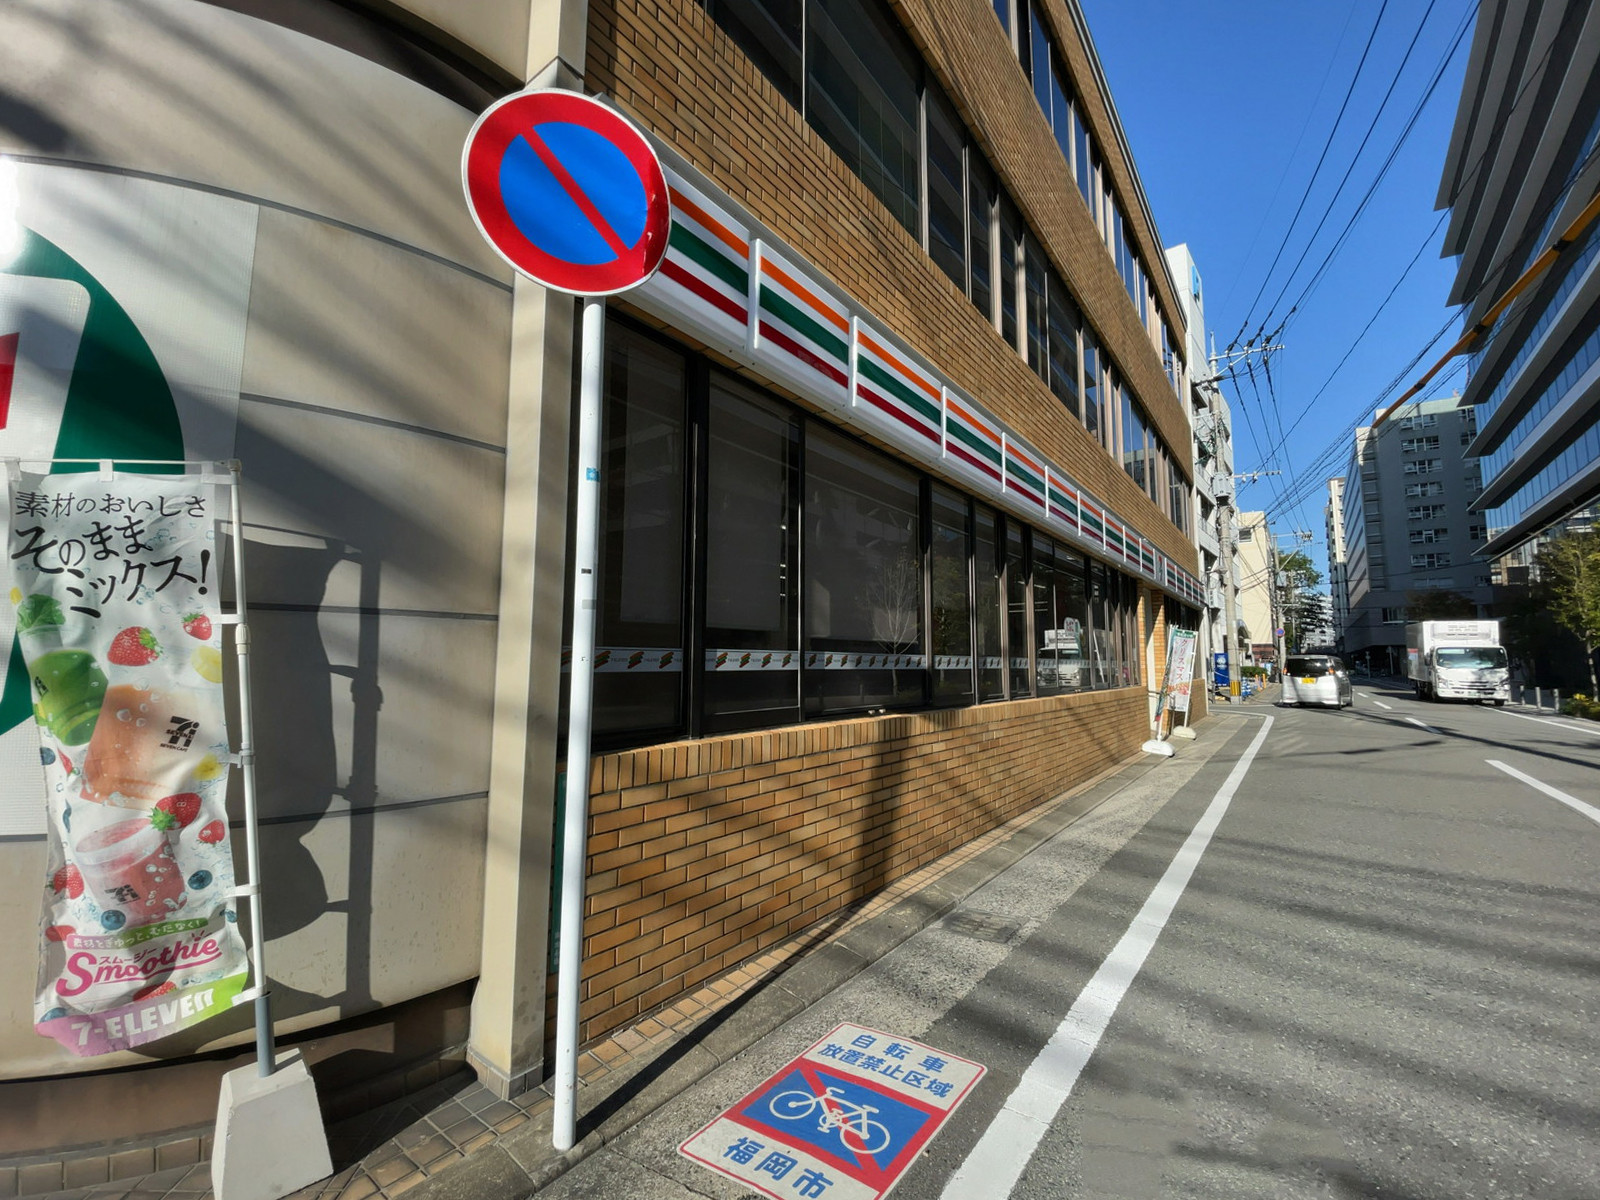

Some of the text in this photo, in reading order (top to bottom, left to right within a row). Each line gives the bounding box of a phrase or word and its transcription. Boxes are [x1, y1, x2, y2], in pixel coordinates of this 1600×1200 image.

[15, 491, 206, 518] 素材のおいしさ
[11, 516, 153, 574] そのまま
[66, 549, 211, 619] ミックス!
[1176, 639, 1187, 680] クリスマス
[55, 936, 220, 997] Smoothie
[99, 948, 156, 964] スムージー
[817, 1043, 954, 1099] 放置禁止区域
[850, 1034, 949, 1073] 自転車
[722, 1136, 834, 1199] 福岡市
